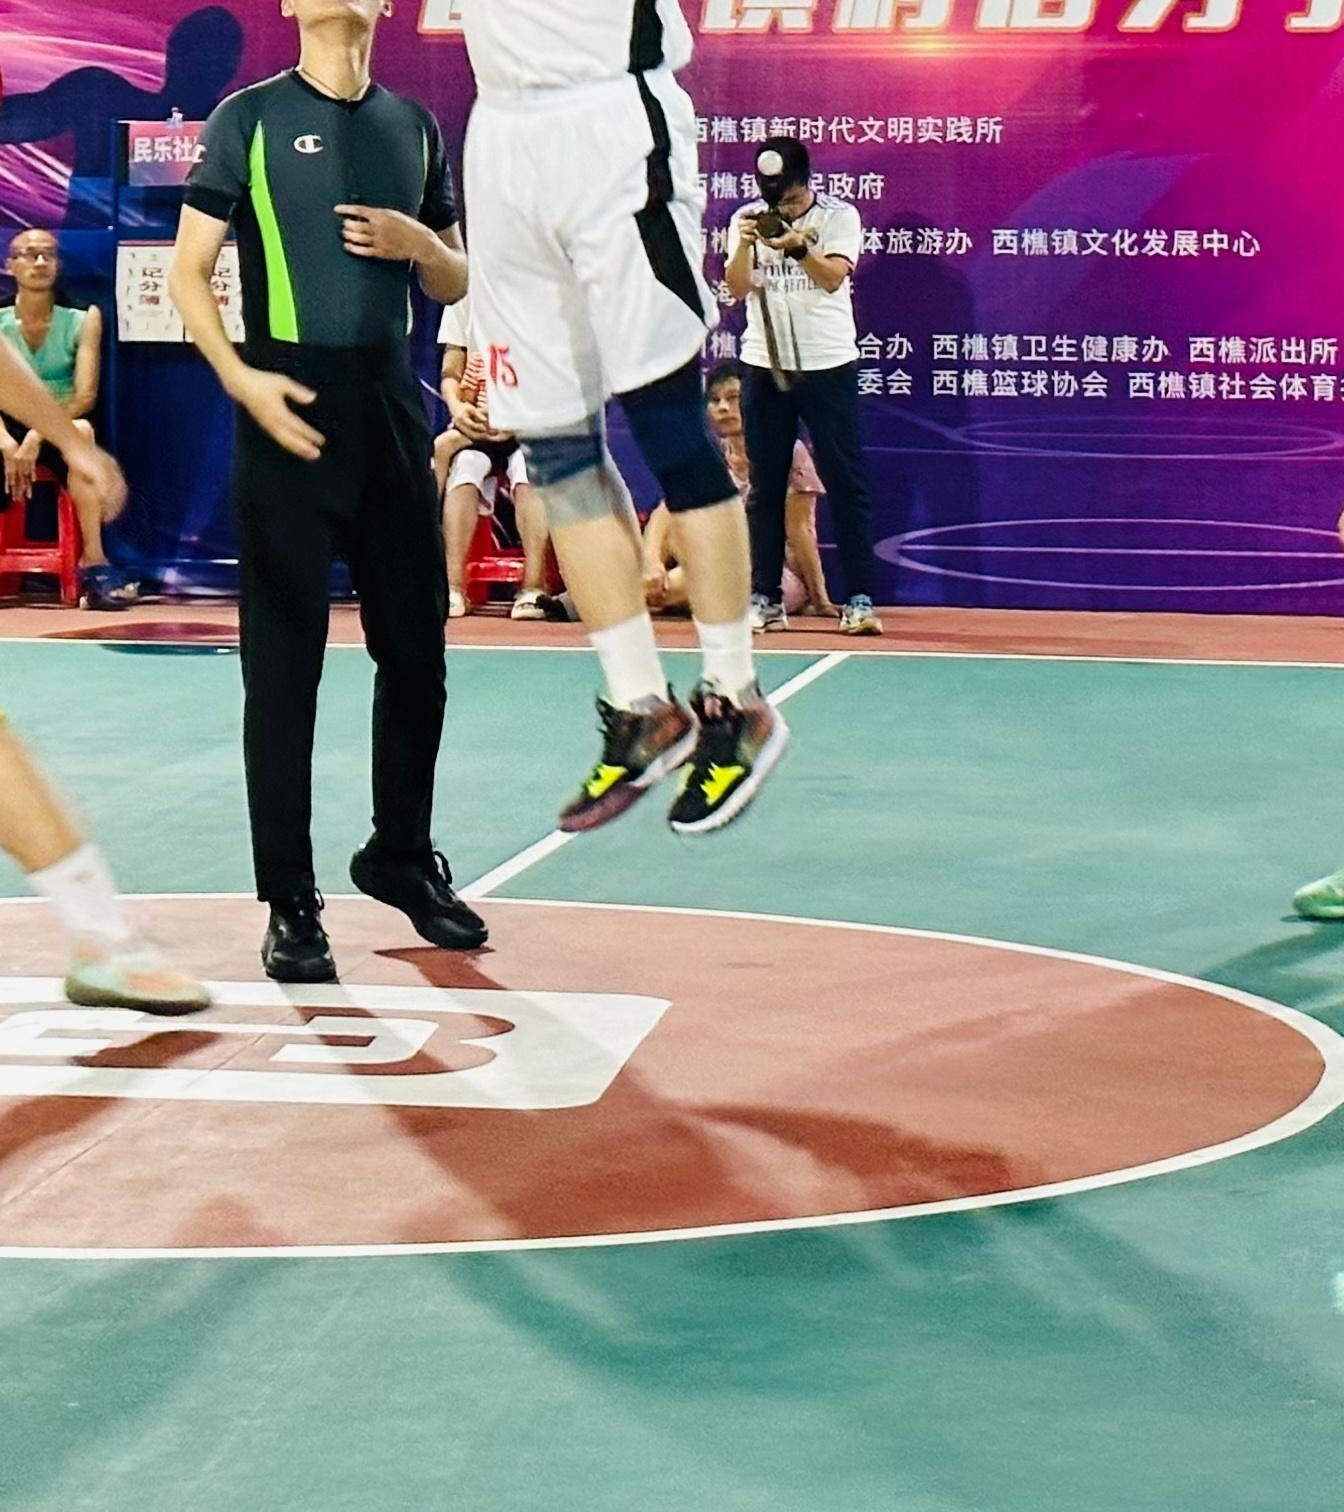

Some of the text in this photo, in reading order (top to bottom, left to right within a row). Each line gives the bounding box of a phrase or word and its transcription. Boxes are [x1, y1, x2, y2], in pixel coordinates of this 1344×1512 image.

[133, 136, 197, 164] 民乐社
[992, 228, 1261, 258] 西樵镇文化发展中心
[932, 334, 1169, 364] 西樵镇卫生健康办
[1189, 337, 1339, 366] 西樵派出所
[932, 369, 1108, 398] 西樵篮球协会
